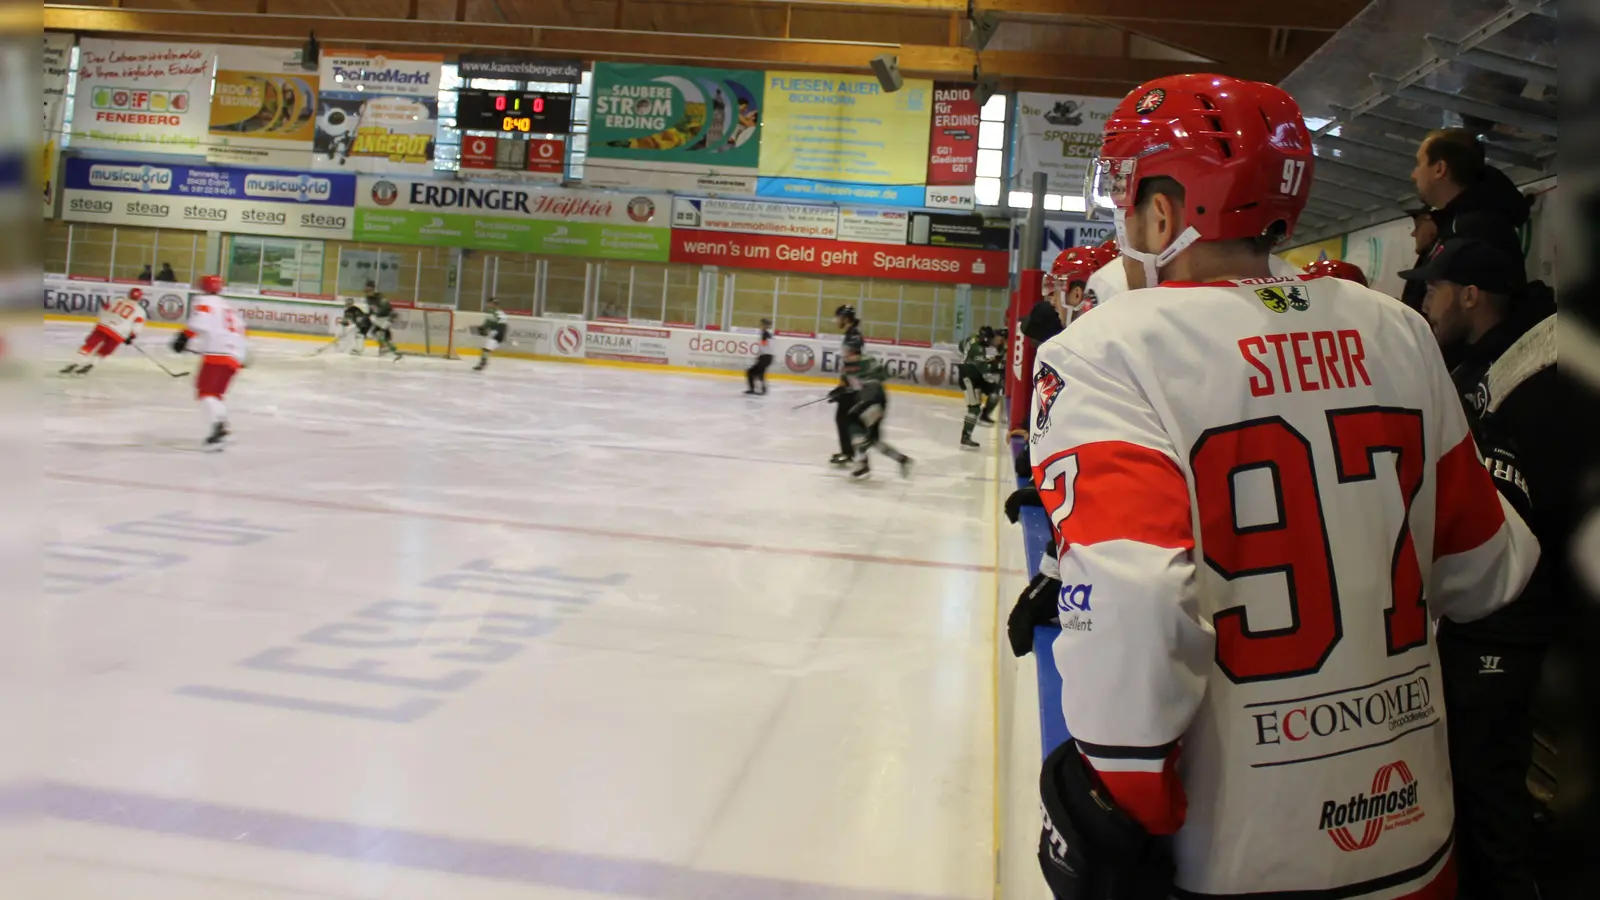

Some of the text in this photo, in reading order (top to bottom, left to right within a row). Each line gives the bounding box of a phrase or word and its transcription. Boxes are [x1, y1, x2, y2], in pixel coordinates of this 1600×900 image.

[332, 66, 430, 84] TechnoMarkt
[462, 61, 578, 76] www.kanzelsberger.de
[612, 84, 672, 99] SAUBERE
[771, 78, 880, 95] FLIESEN AUER
[935, 89, 971, 101] RADIO
[495, 96, 544, 112] 0 1 0
[596, 96, 672, 117] STROM
[935, 102, 952, 114] für
[96, 111, 180, 126] FENEBERG
[503, 117, 530, 131] 0:40
[605, 115, 666, 130] ERDING
[935, 115, 979, 127] ERDING
[352, 134, 430, 155] ANGEBOT
[1043, 130, 1104, 146] SPORTPA
[91, 168, 170, 184] musicworld
[1280, 159, 1305, 196] 97
[247, 177, 329, 194] musicworld
[409, 182, 612, 217] ERDINGER Weißbier
[930, 194, 971, 204] TOP FM
[70, 197, 346, 229] steag steag steag steag steag
[1080, 227, 1108, 239] MIC
[684, 240, 960, 272] wenn's um Geld geht Sparkasse
[44, 289, 150, 319] ERDINR
[113, 301, 135, 320] 10
[586, 333, 633, 348] RATAJAK
[1238, 329, 1372, 397] STERR
[1190, 405, 1430, 684] 97
[1058, 584, 1093, 612] ra
[1252, 676, 1430, 746] ECONOMED
[1318, 779, 1418, 831] Rothmoser
